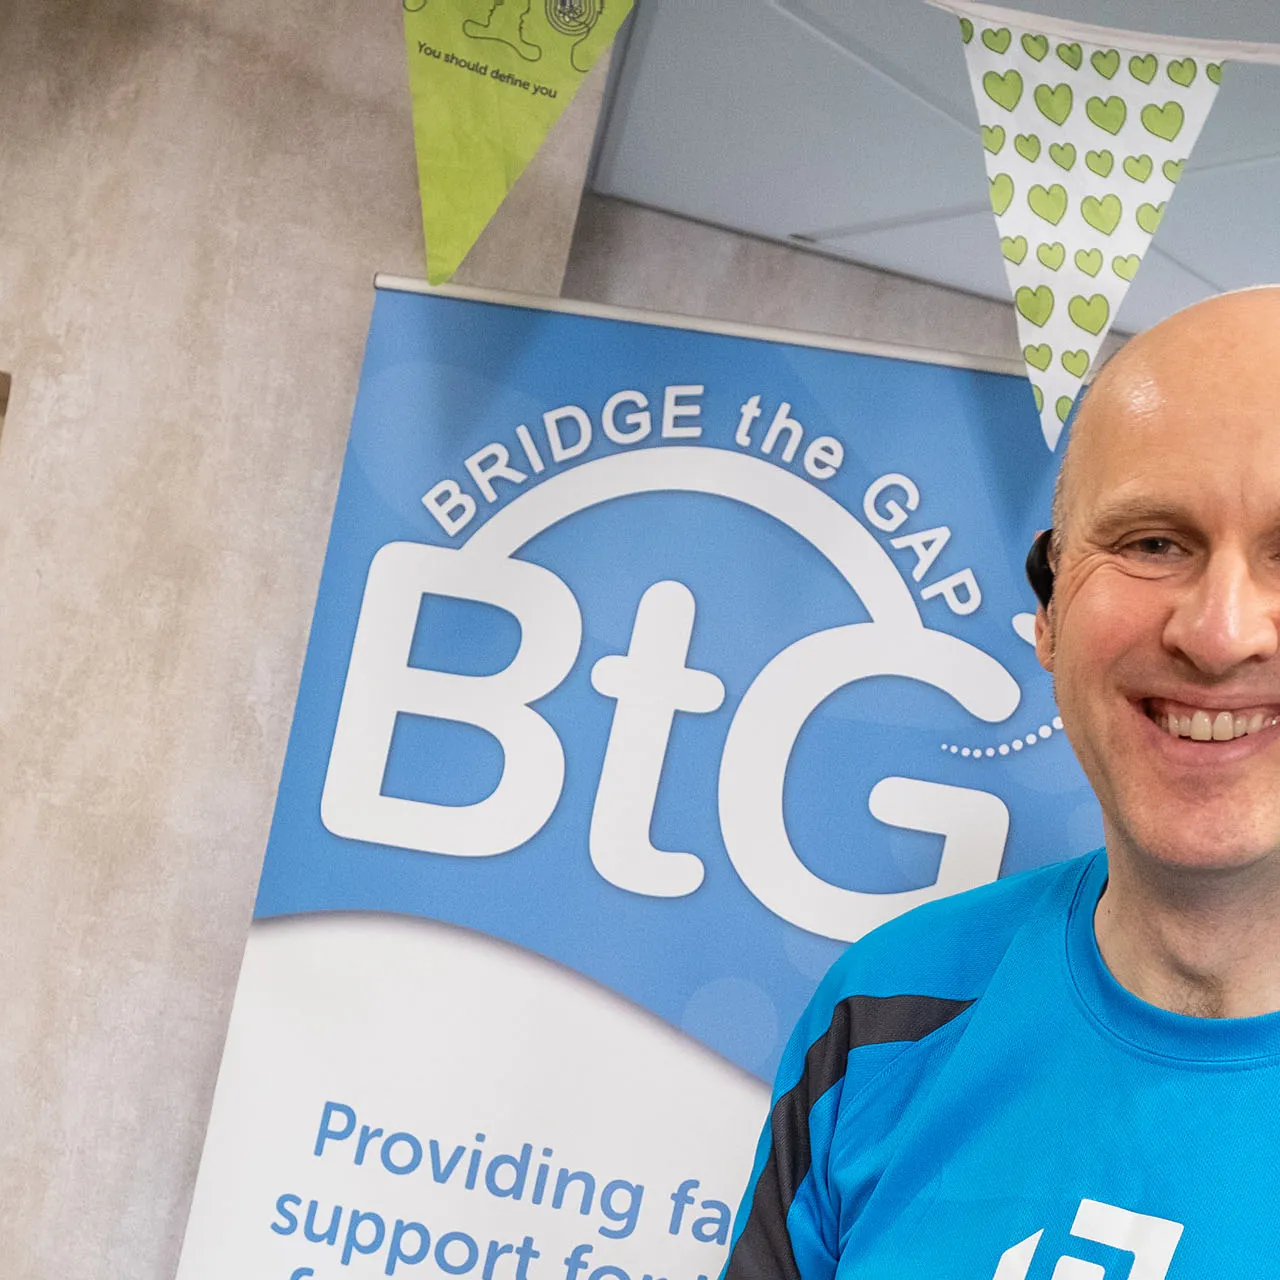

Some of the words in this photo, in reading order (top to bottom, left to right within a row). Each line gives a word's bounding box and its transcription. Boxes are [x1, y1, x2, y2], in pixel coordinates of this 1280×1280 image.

[417, 41, 441, 60] You
[444, 52, 488, 76] should
[490, 69, 530, 91] define
[532, 83, 557, 99] you
[422, 385, 705, 537] BRIDGE
[734, 394, 843, 480] the
[863, 472, 982, 617] GAP
[320, 540, 1022, 945] BtG
[314, 1101, 644, 1240] Providing
